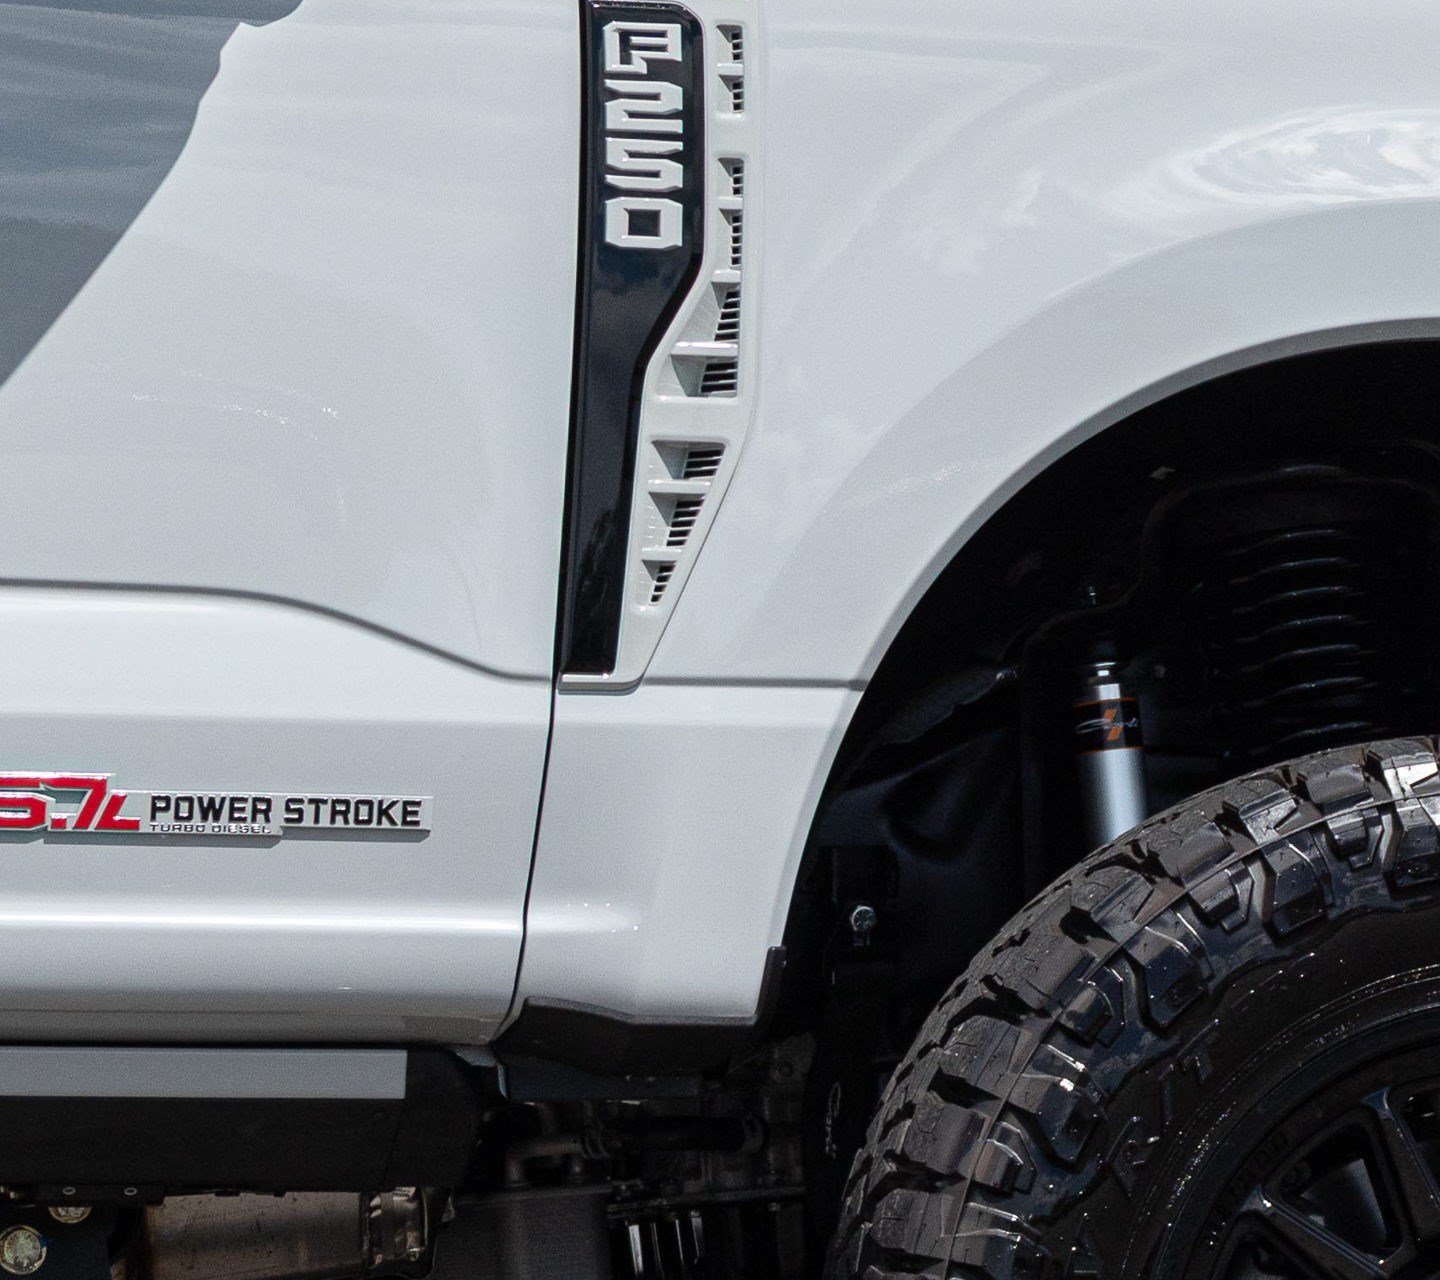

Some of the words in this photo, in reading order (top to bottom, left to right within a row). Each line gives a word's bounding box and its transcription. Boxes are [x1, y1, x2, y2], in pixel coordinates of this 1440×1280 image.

[602, 20, 684, 250] F250
[150, 794, 274, 823] POWER
[284, 796, 422, 828] STROKE
[150, 823, 206, 834] TURBO
[211, 823, 272, 835] DIESEL
